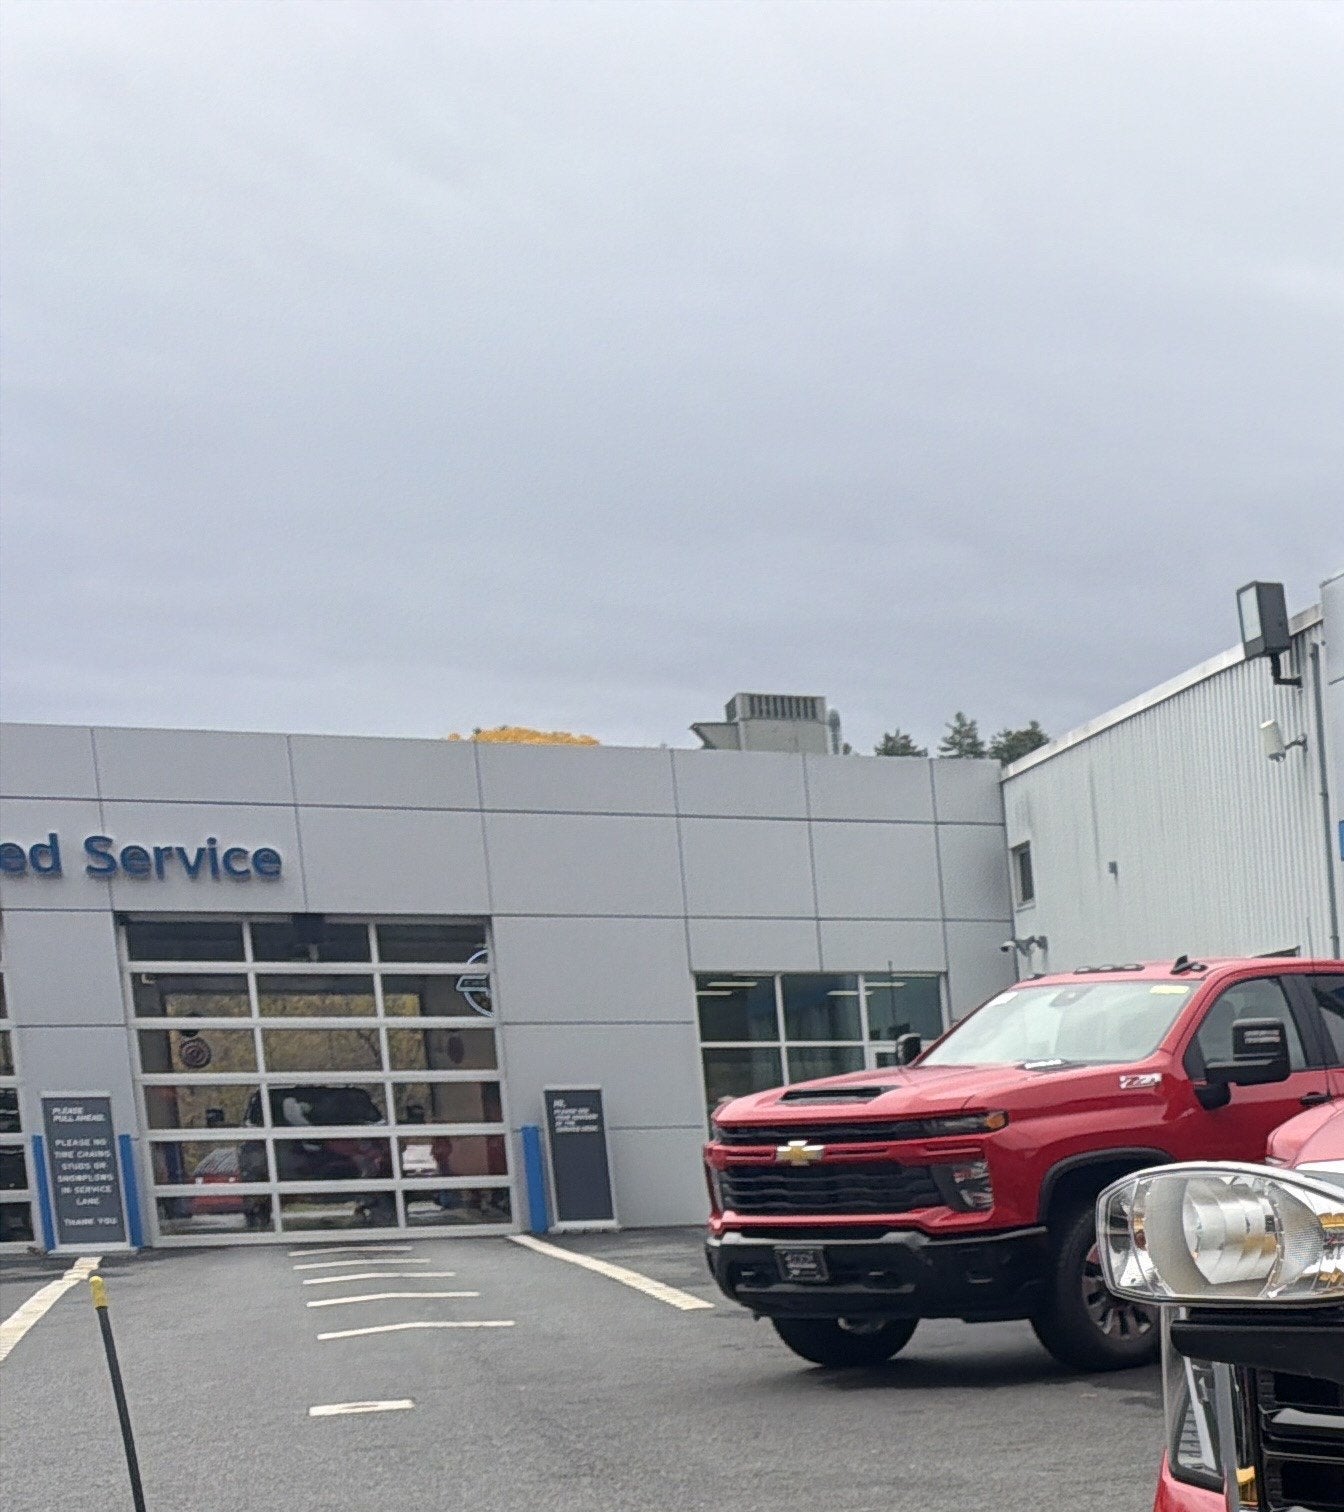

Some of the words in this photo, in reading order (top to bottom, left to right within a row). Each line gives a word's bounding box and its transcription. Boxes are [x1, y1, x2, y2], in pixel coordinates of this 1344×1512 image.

[84, 834, 283, 882] Service
[55, 1138, 91, 1147] PLEASE
[63, 1218, 94, 1227] THANK
[98, 1216, 118, 1225] YOU
